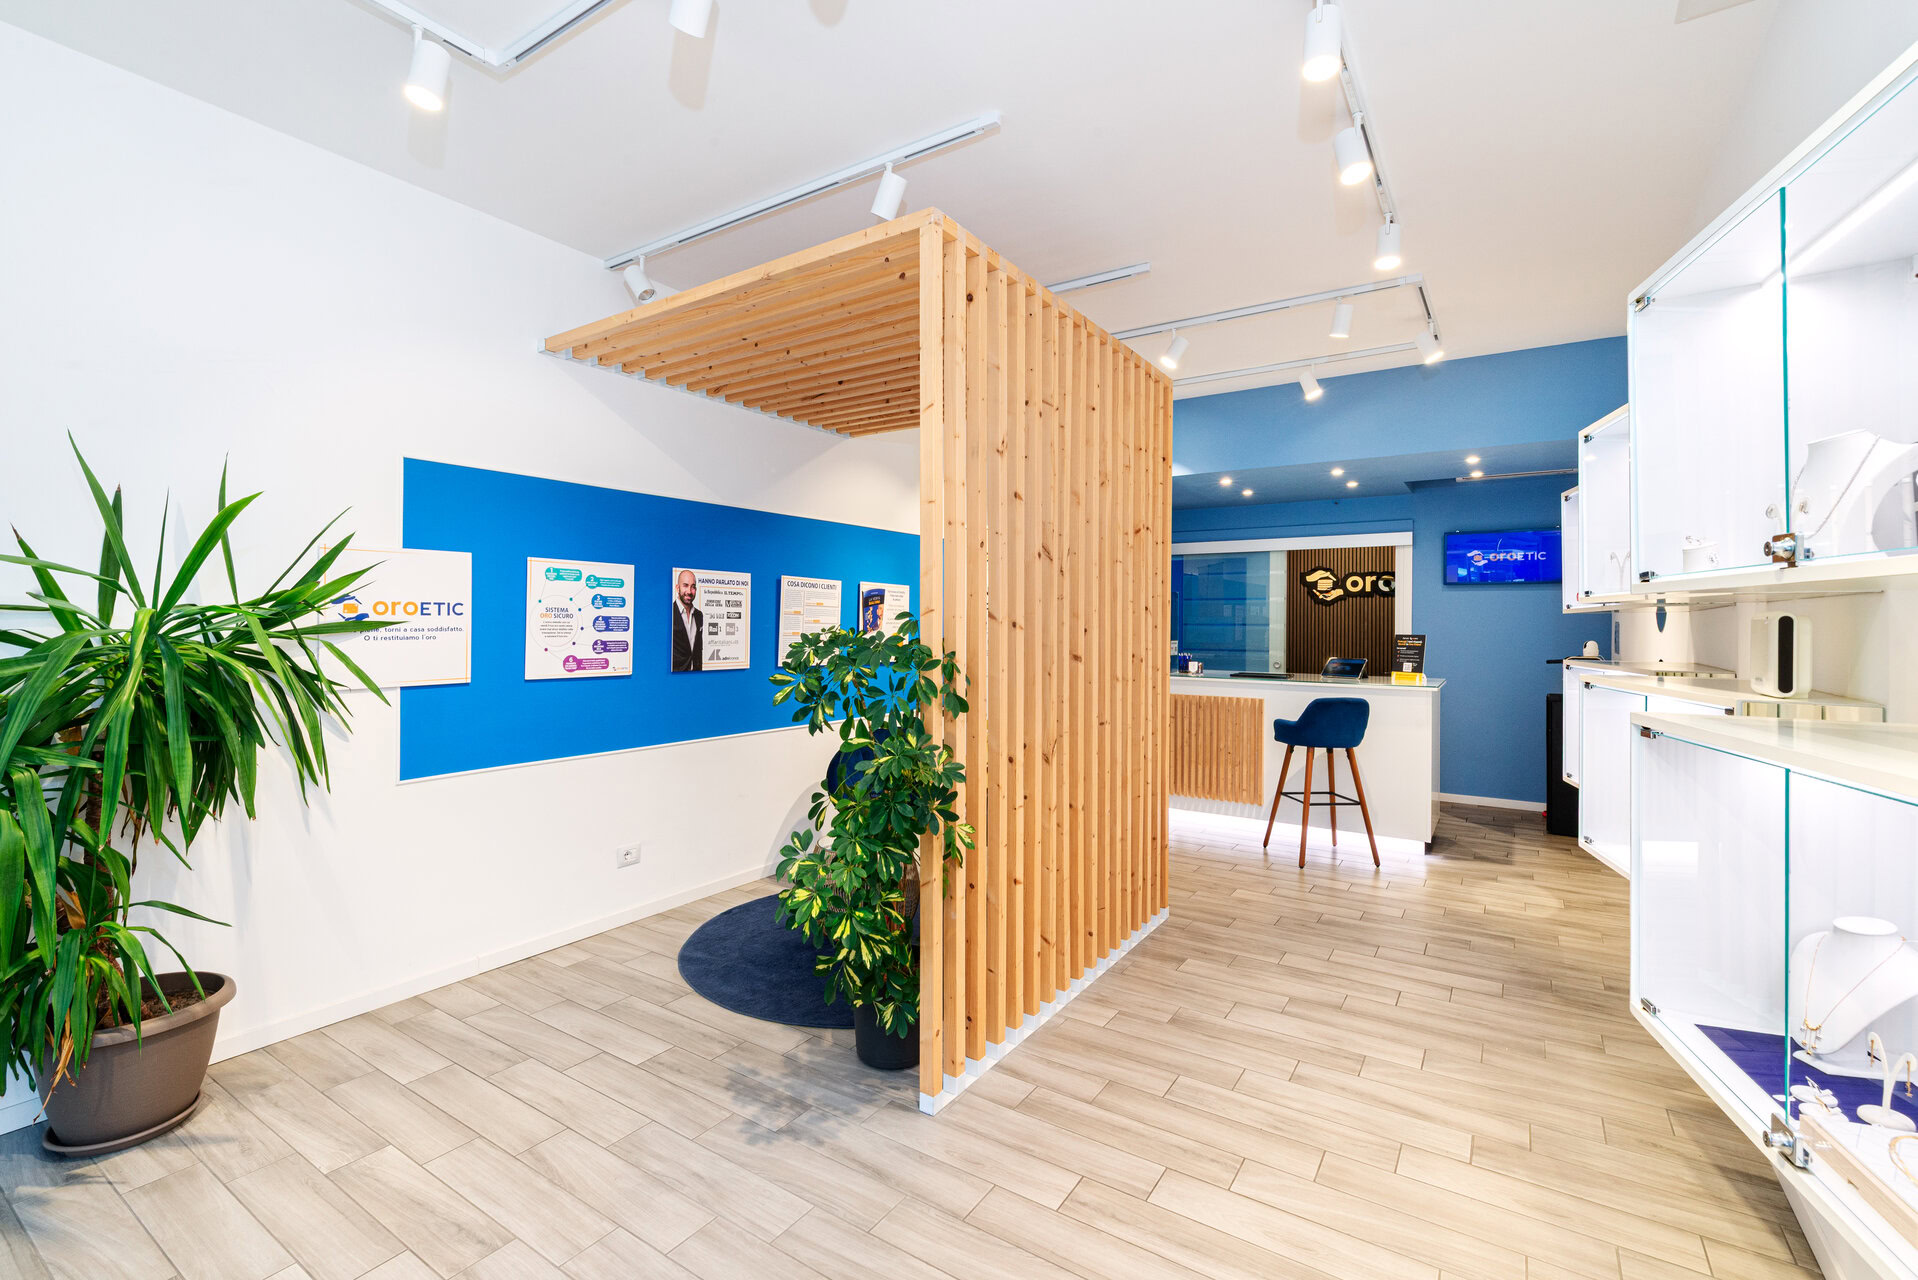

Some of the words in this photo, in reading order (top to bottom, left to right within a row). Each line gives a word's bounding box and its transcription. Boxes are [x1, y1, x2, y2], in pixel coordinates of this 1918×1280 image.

[1490, 552, 1546, 561] oroETIC
[800, 581, 818, 589] DICONO
[1345, 575, 1395, 592] oro
[372, 600, 464, 616] oroETIC
